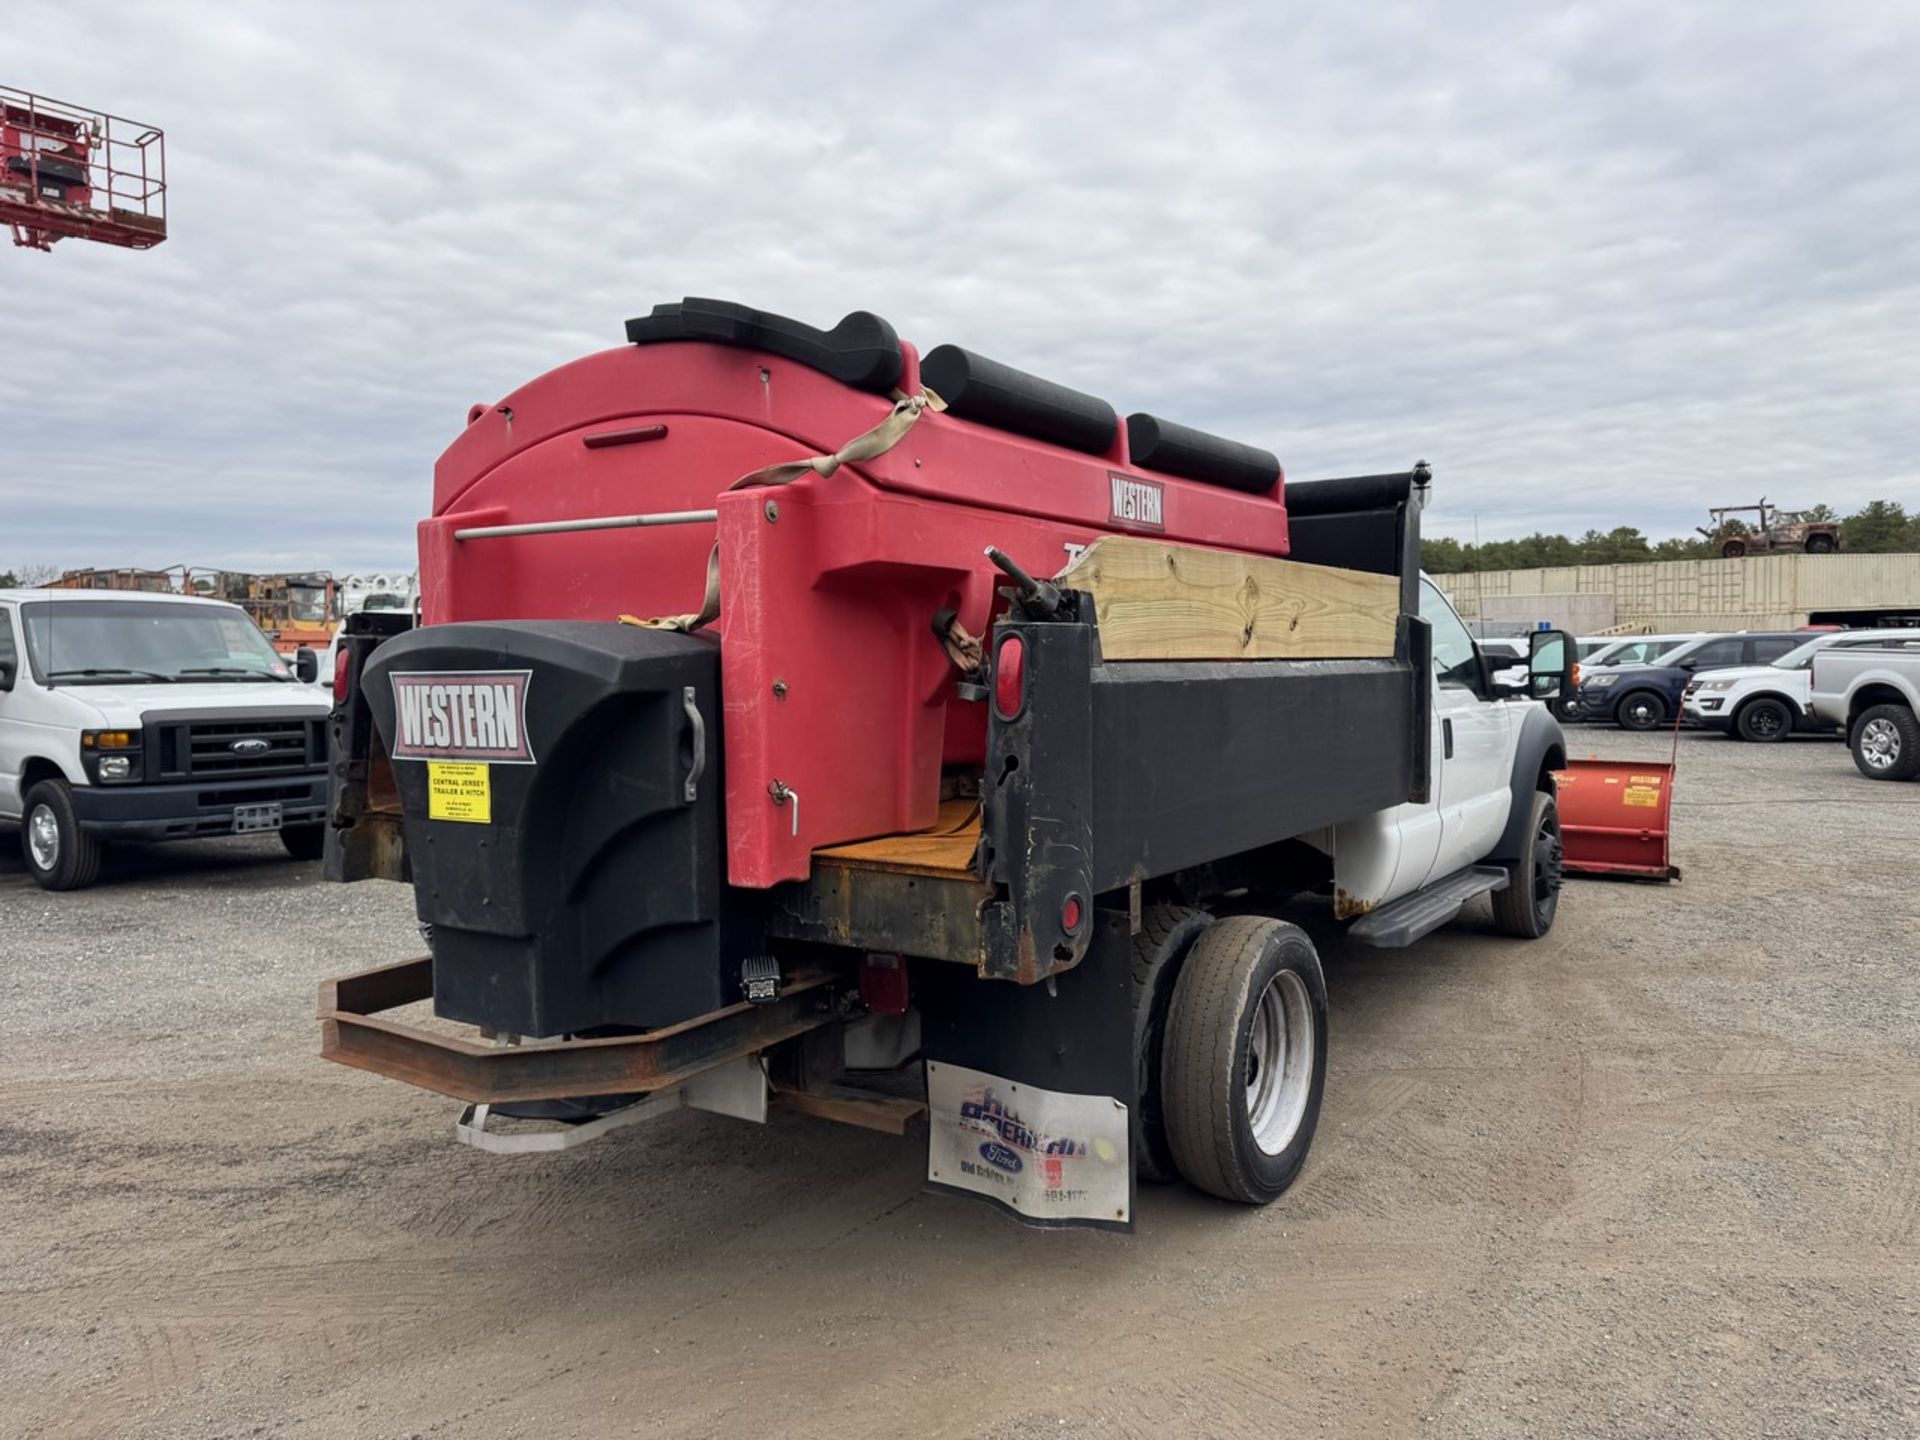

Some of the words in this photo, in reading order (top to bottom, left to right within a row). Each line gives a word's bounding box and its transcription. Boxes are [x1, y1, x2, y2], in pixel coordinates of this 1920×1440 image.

[1112, 478, 1162, 525] WESTERN
[399, 684, 518, 749] WESTERN
[433, 778, 459, 787] CENTRAL
[462, 779, 485, 787] JERSEY
[433, 787, 459, 796] TRAILER
[985, 1144, 1019, 1170] Ford
